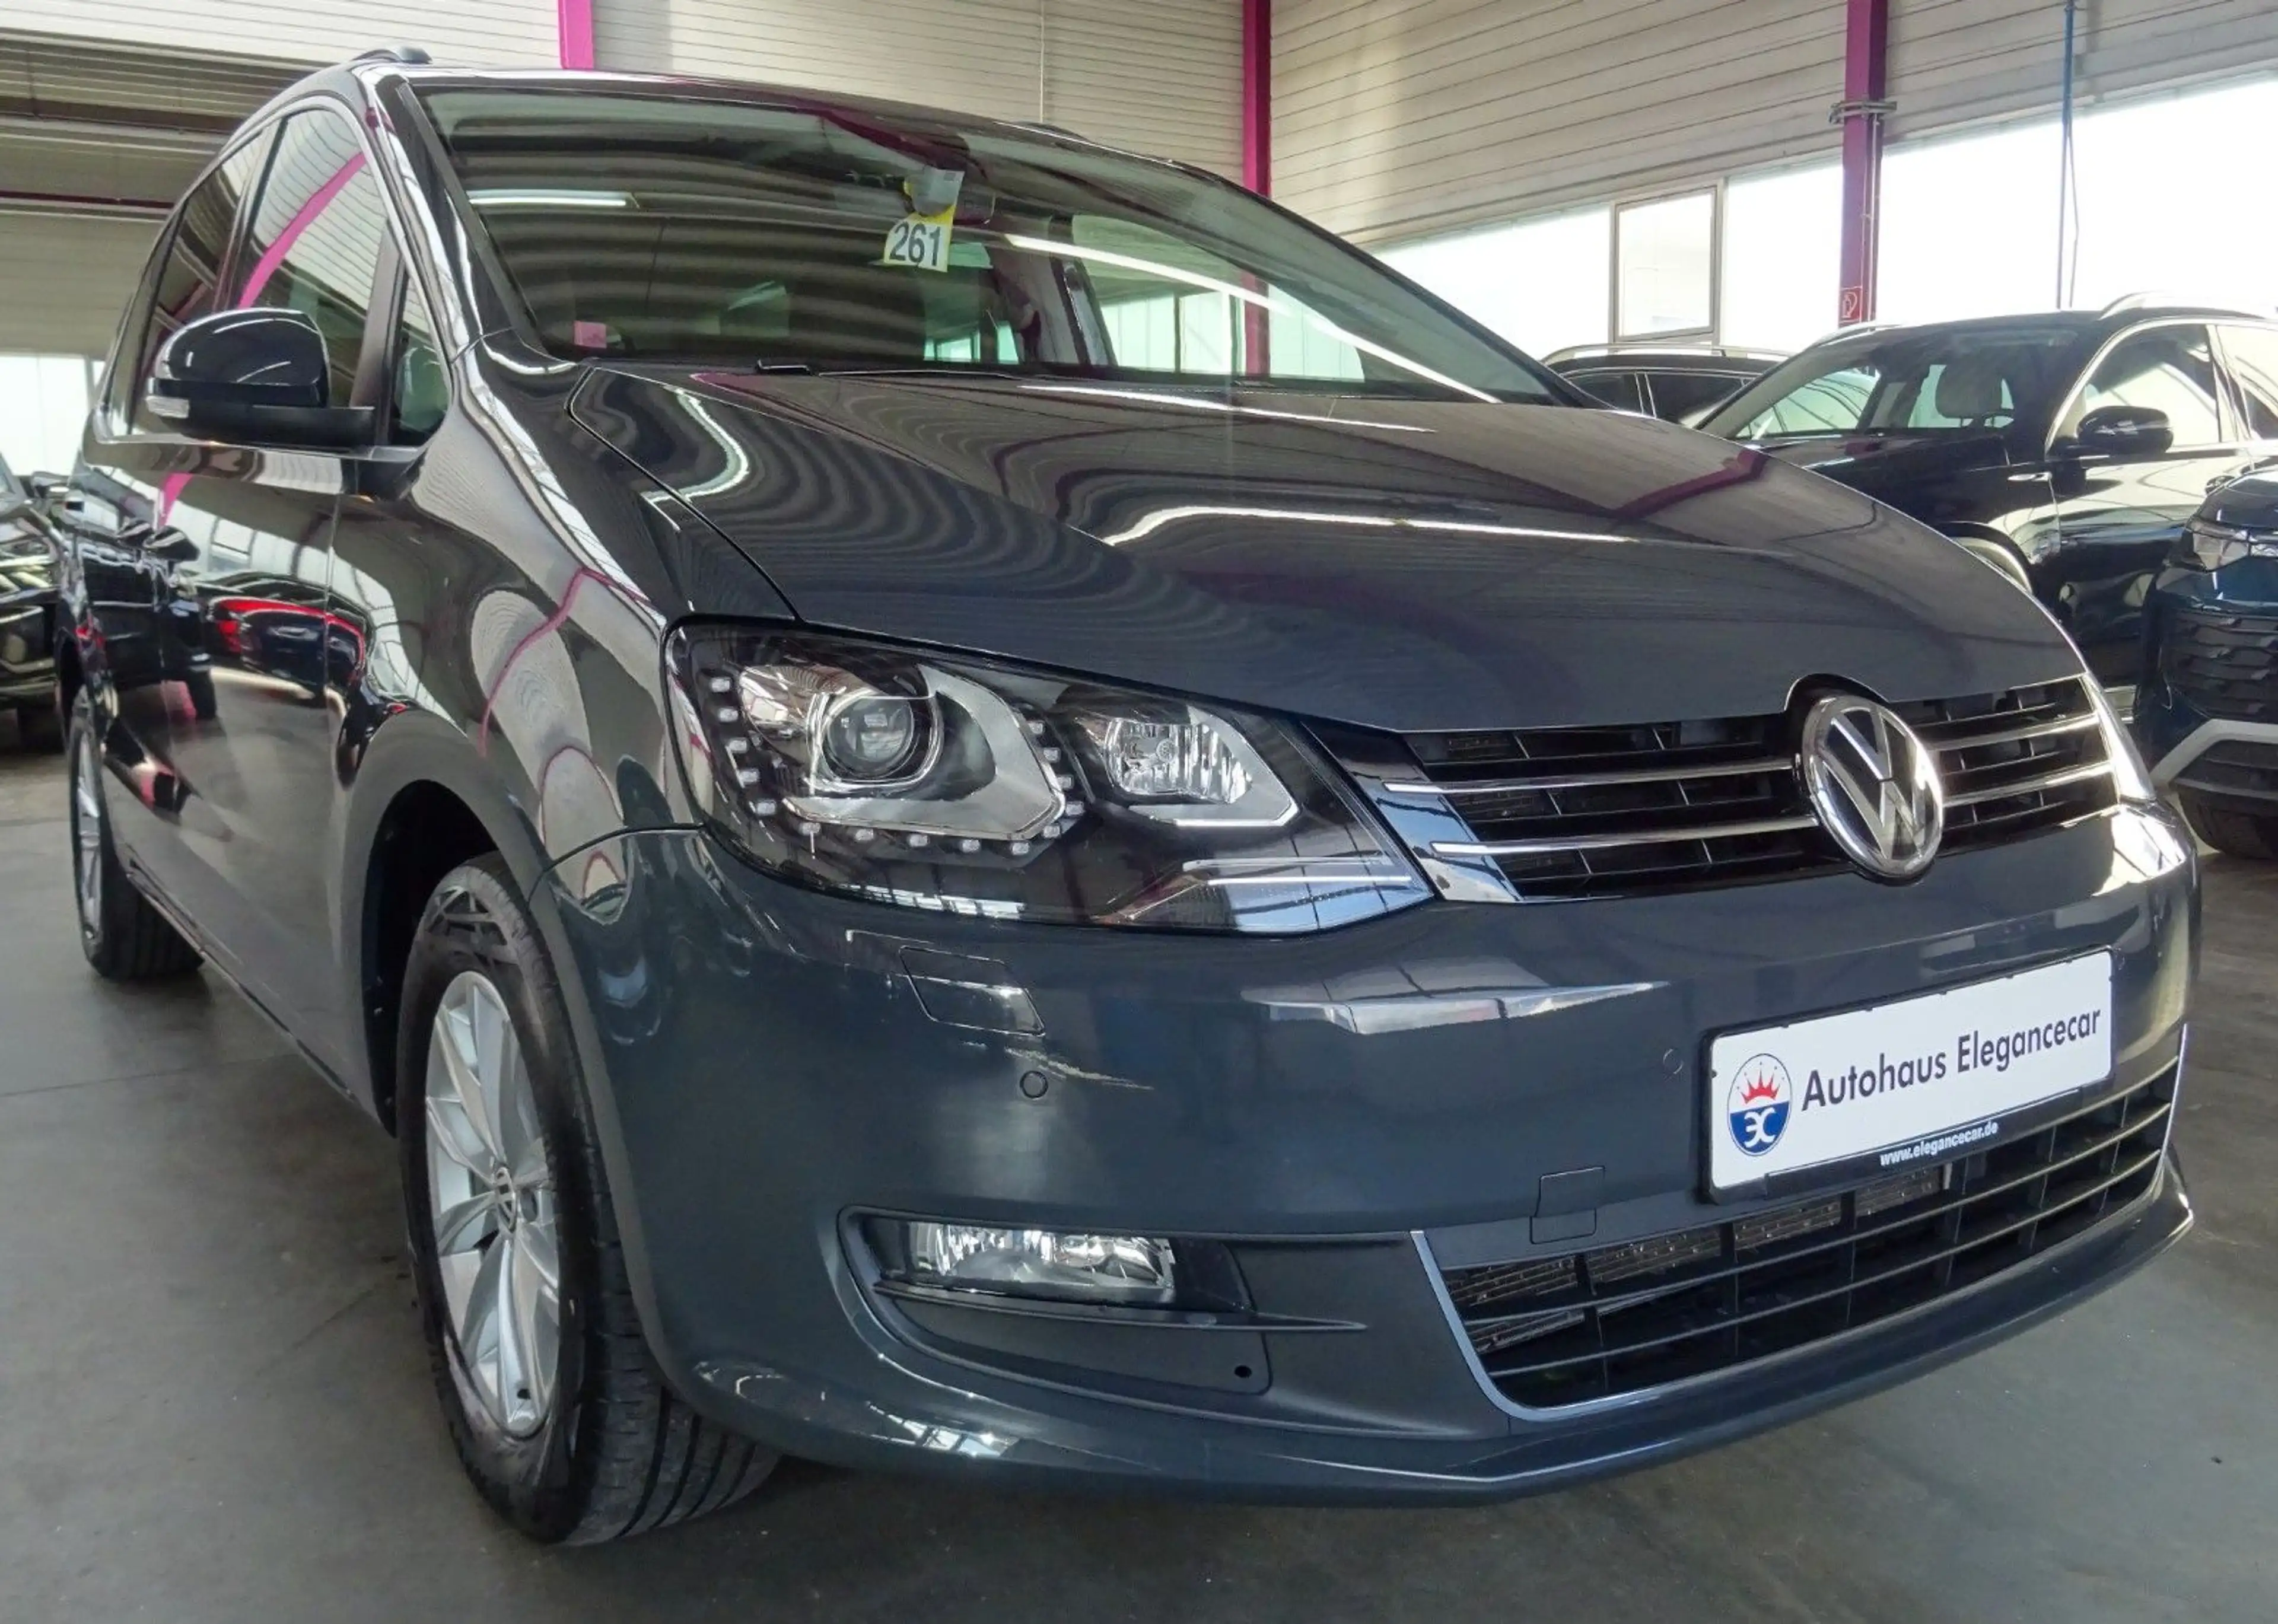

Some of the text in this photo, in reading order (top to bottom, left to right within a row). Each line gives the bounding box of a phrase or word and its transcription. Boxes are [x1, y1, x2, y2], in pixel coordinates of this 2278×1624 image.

[889, 221, 941, 266] 261
[1801, 1009, 2101, 1112] Autohaus Elegancecar
[1879, 1120, 1999, 1166] www.elegancecar.de
